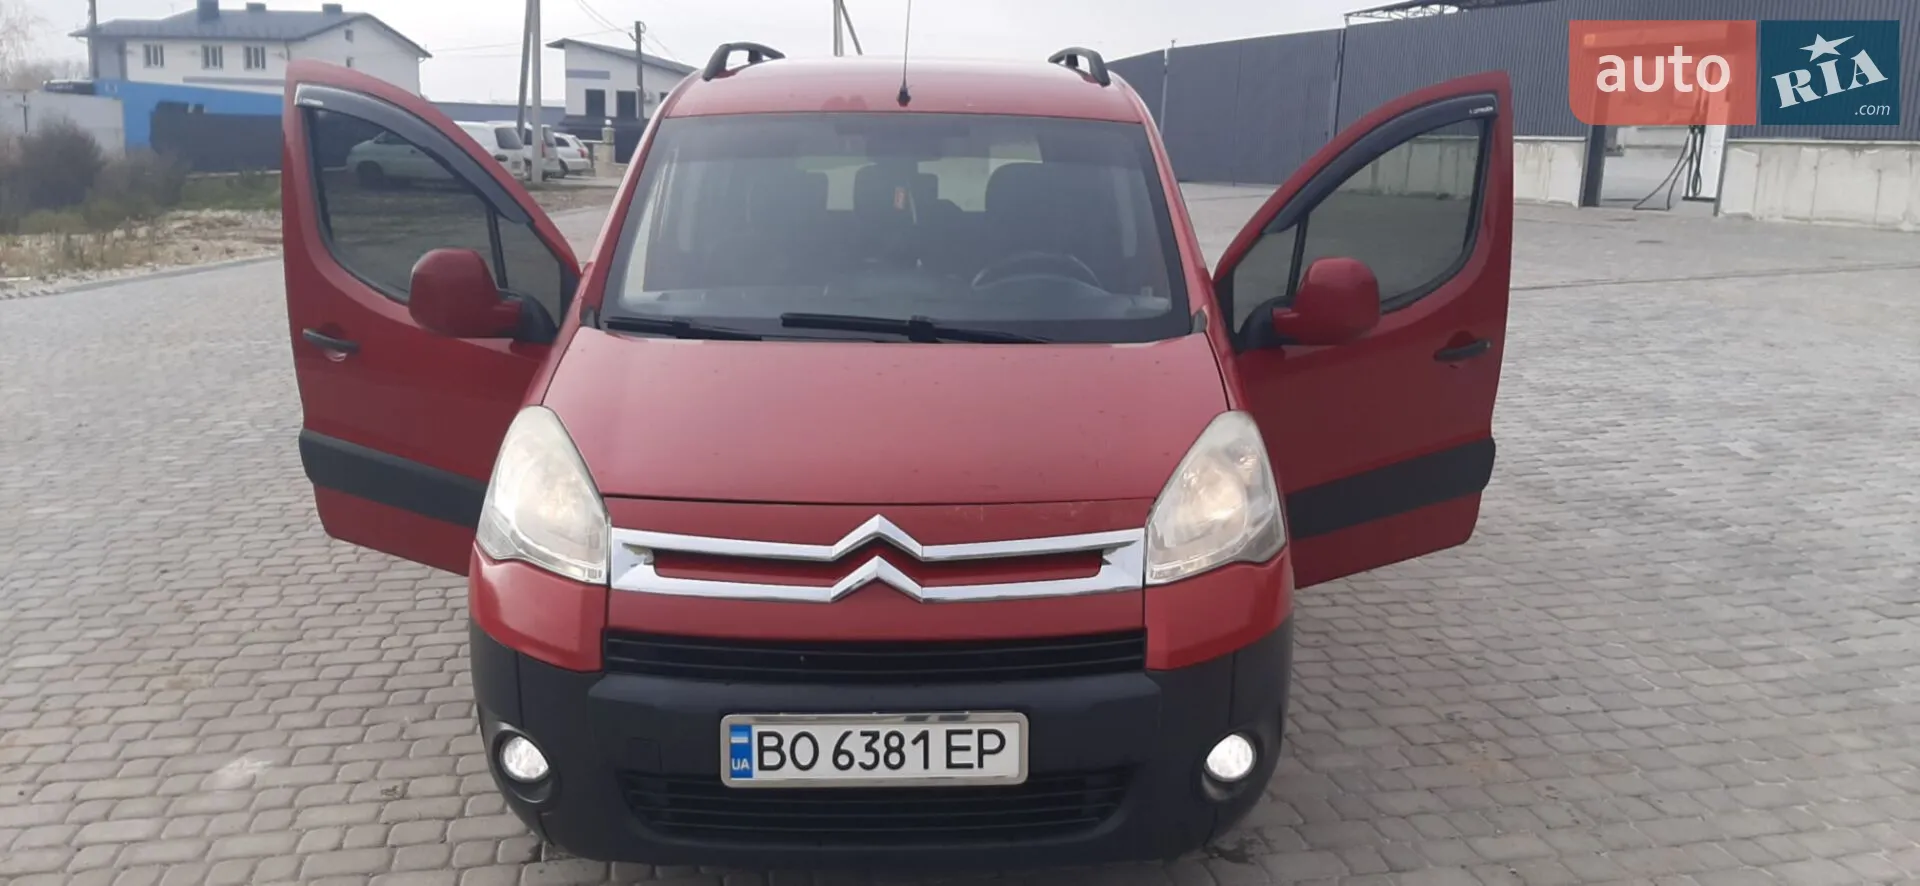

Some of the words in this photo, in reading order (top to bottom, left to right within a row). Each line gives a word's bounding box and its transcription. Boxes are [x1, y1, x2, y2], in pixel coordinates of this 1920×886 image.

[731, 757, 750, 771] UA
[757, 730, 820, 772] BO
[832, 729, 930, 771] 6381
[945, 728, 1006, 770] EP
